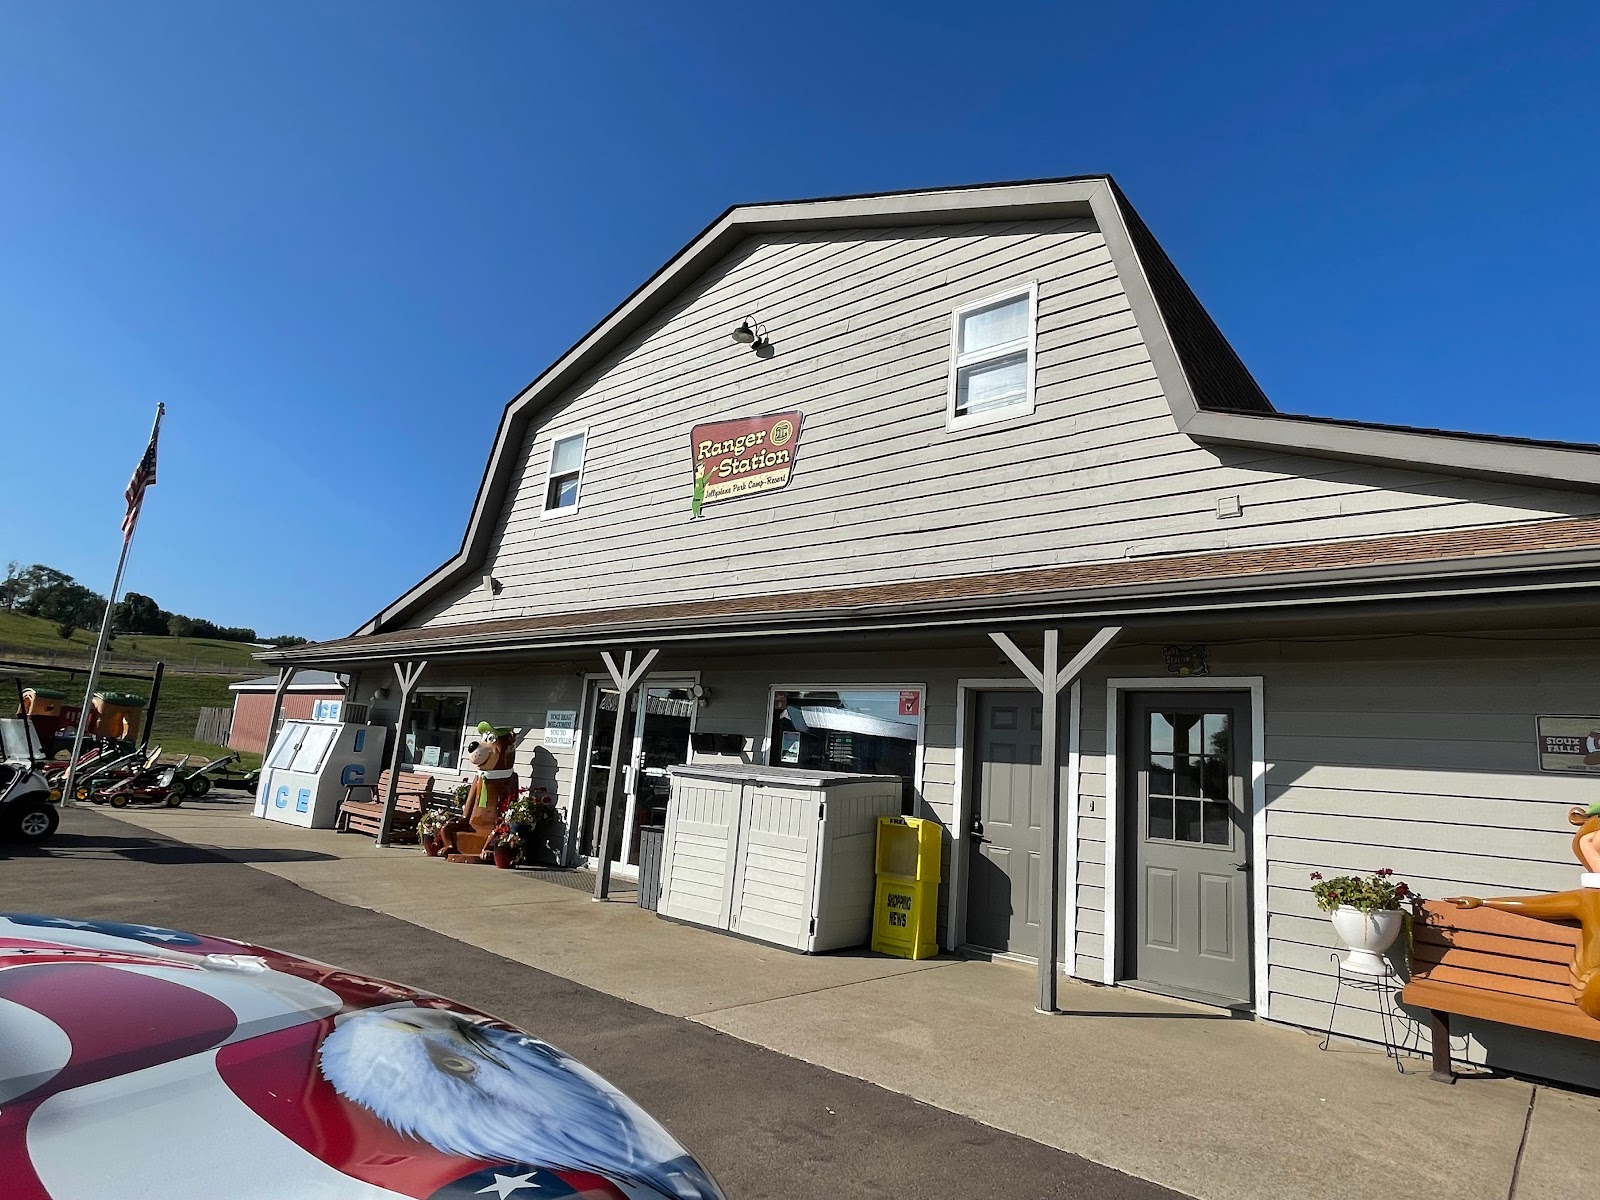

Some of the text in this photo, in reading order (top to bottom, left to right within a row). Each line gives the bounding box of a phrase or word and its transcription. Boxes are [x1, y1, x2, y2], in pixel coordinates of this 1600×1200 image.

[697, 430, 767, 460] Ranger
[718, 449, 790, 478] Station
[733, 482, 747, 493] Park
[314, 703, 339, 719] ICE
[1546, 736, 1580, 745] SIOUX
[1547, 744, 1580, 753] FALLS
[261, 783, 311, 813] ICE
[886, 893, 912, 911] SHOPPING
[888, 911, 907, 928] NEWS
